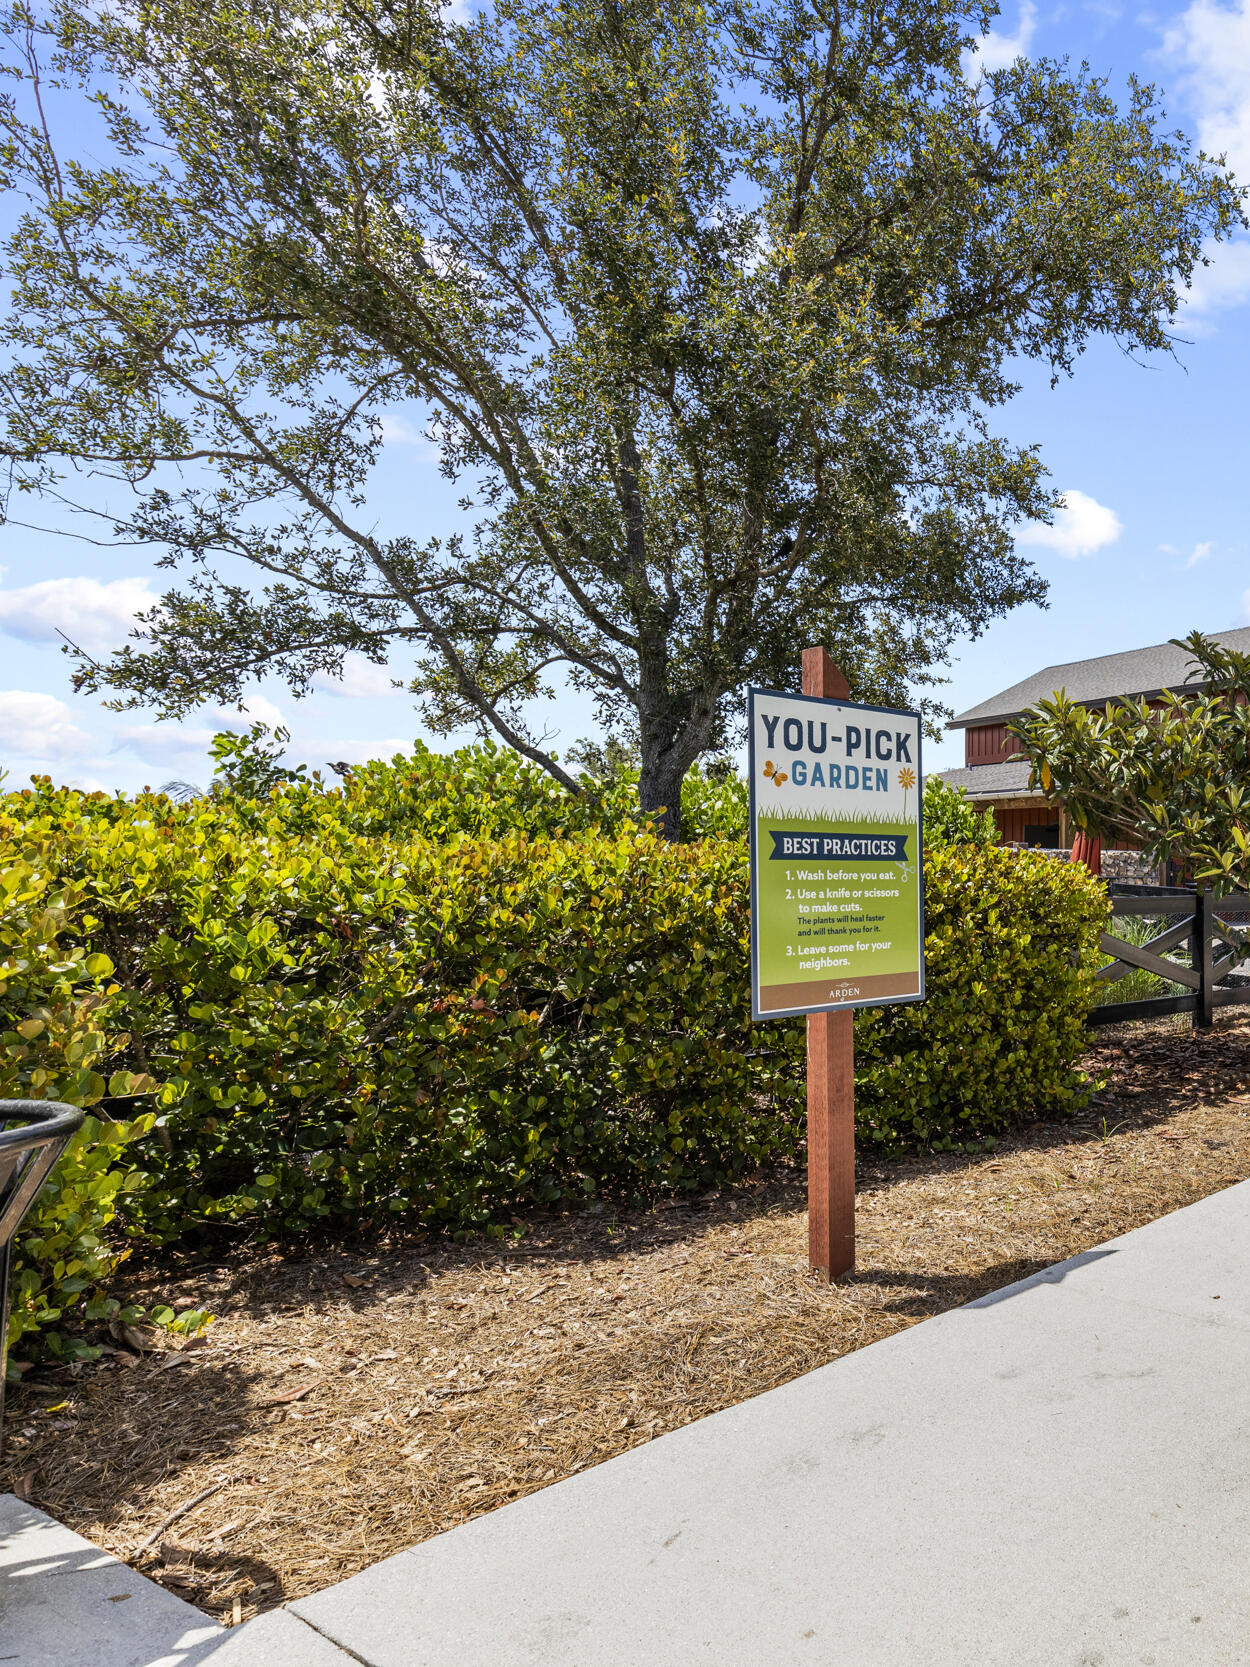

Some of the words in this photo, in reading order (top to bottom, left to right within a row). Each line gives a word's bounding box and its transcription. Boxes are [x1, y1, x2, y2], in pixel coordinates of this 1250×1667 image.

[761, 714, 912, 763] YOU-PICK
[792, 760, 888, 792] GARDEN
[783, 838, 819, 854] BEST
[823, 839, 896, 856] PRACTICES
[785, 870, 794, 880] 1.
[796, 870, 824, 880] Wash
[827, 870, 858, 880] before
[860, 872, 877, 882] you
[879, 871, 896, 880] eat.
[785, 889, 795, 899] 2.
[797, 889, 816, 899] Use
[827, 888, 850, 898] knife
[864, 888, 899, 897] scissors
[798, 904, 810, 913] to
[812, 903, 837, 912] make
[840, 903, 862, 912] cuts.
[797, 917, 811, 925] The
[813, 916, 835, 925] plants
[836, 915, 849, 923] will
[797, 928, 811, 937] and
[813, 927, 825, 935] will
[827, 926, 847, 935] thank
[849, 927, 861, 936] you
[786, 945, 796, 956] 3.
[798, 945, 826, 955] Leave
[828, 944, 854, 953] some
[856, 941, 869, 951] for
[871, 941, 892, 952] your
[799, 957, 851, 971] neighbors.
[829, 987, 860, 998] ARDEN
